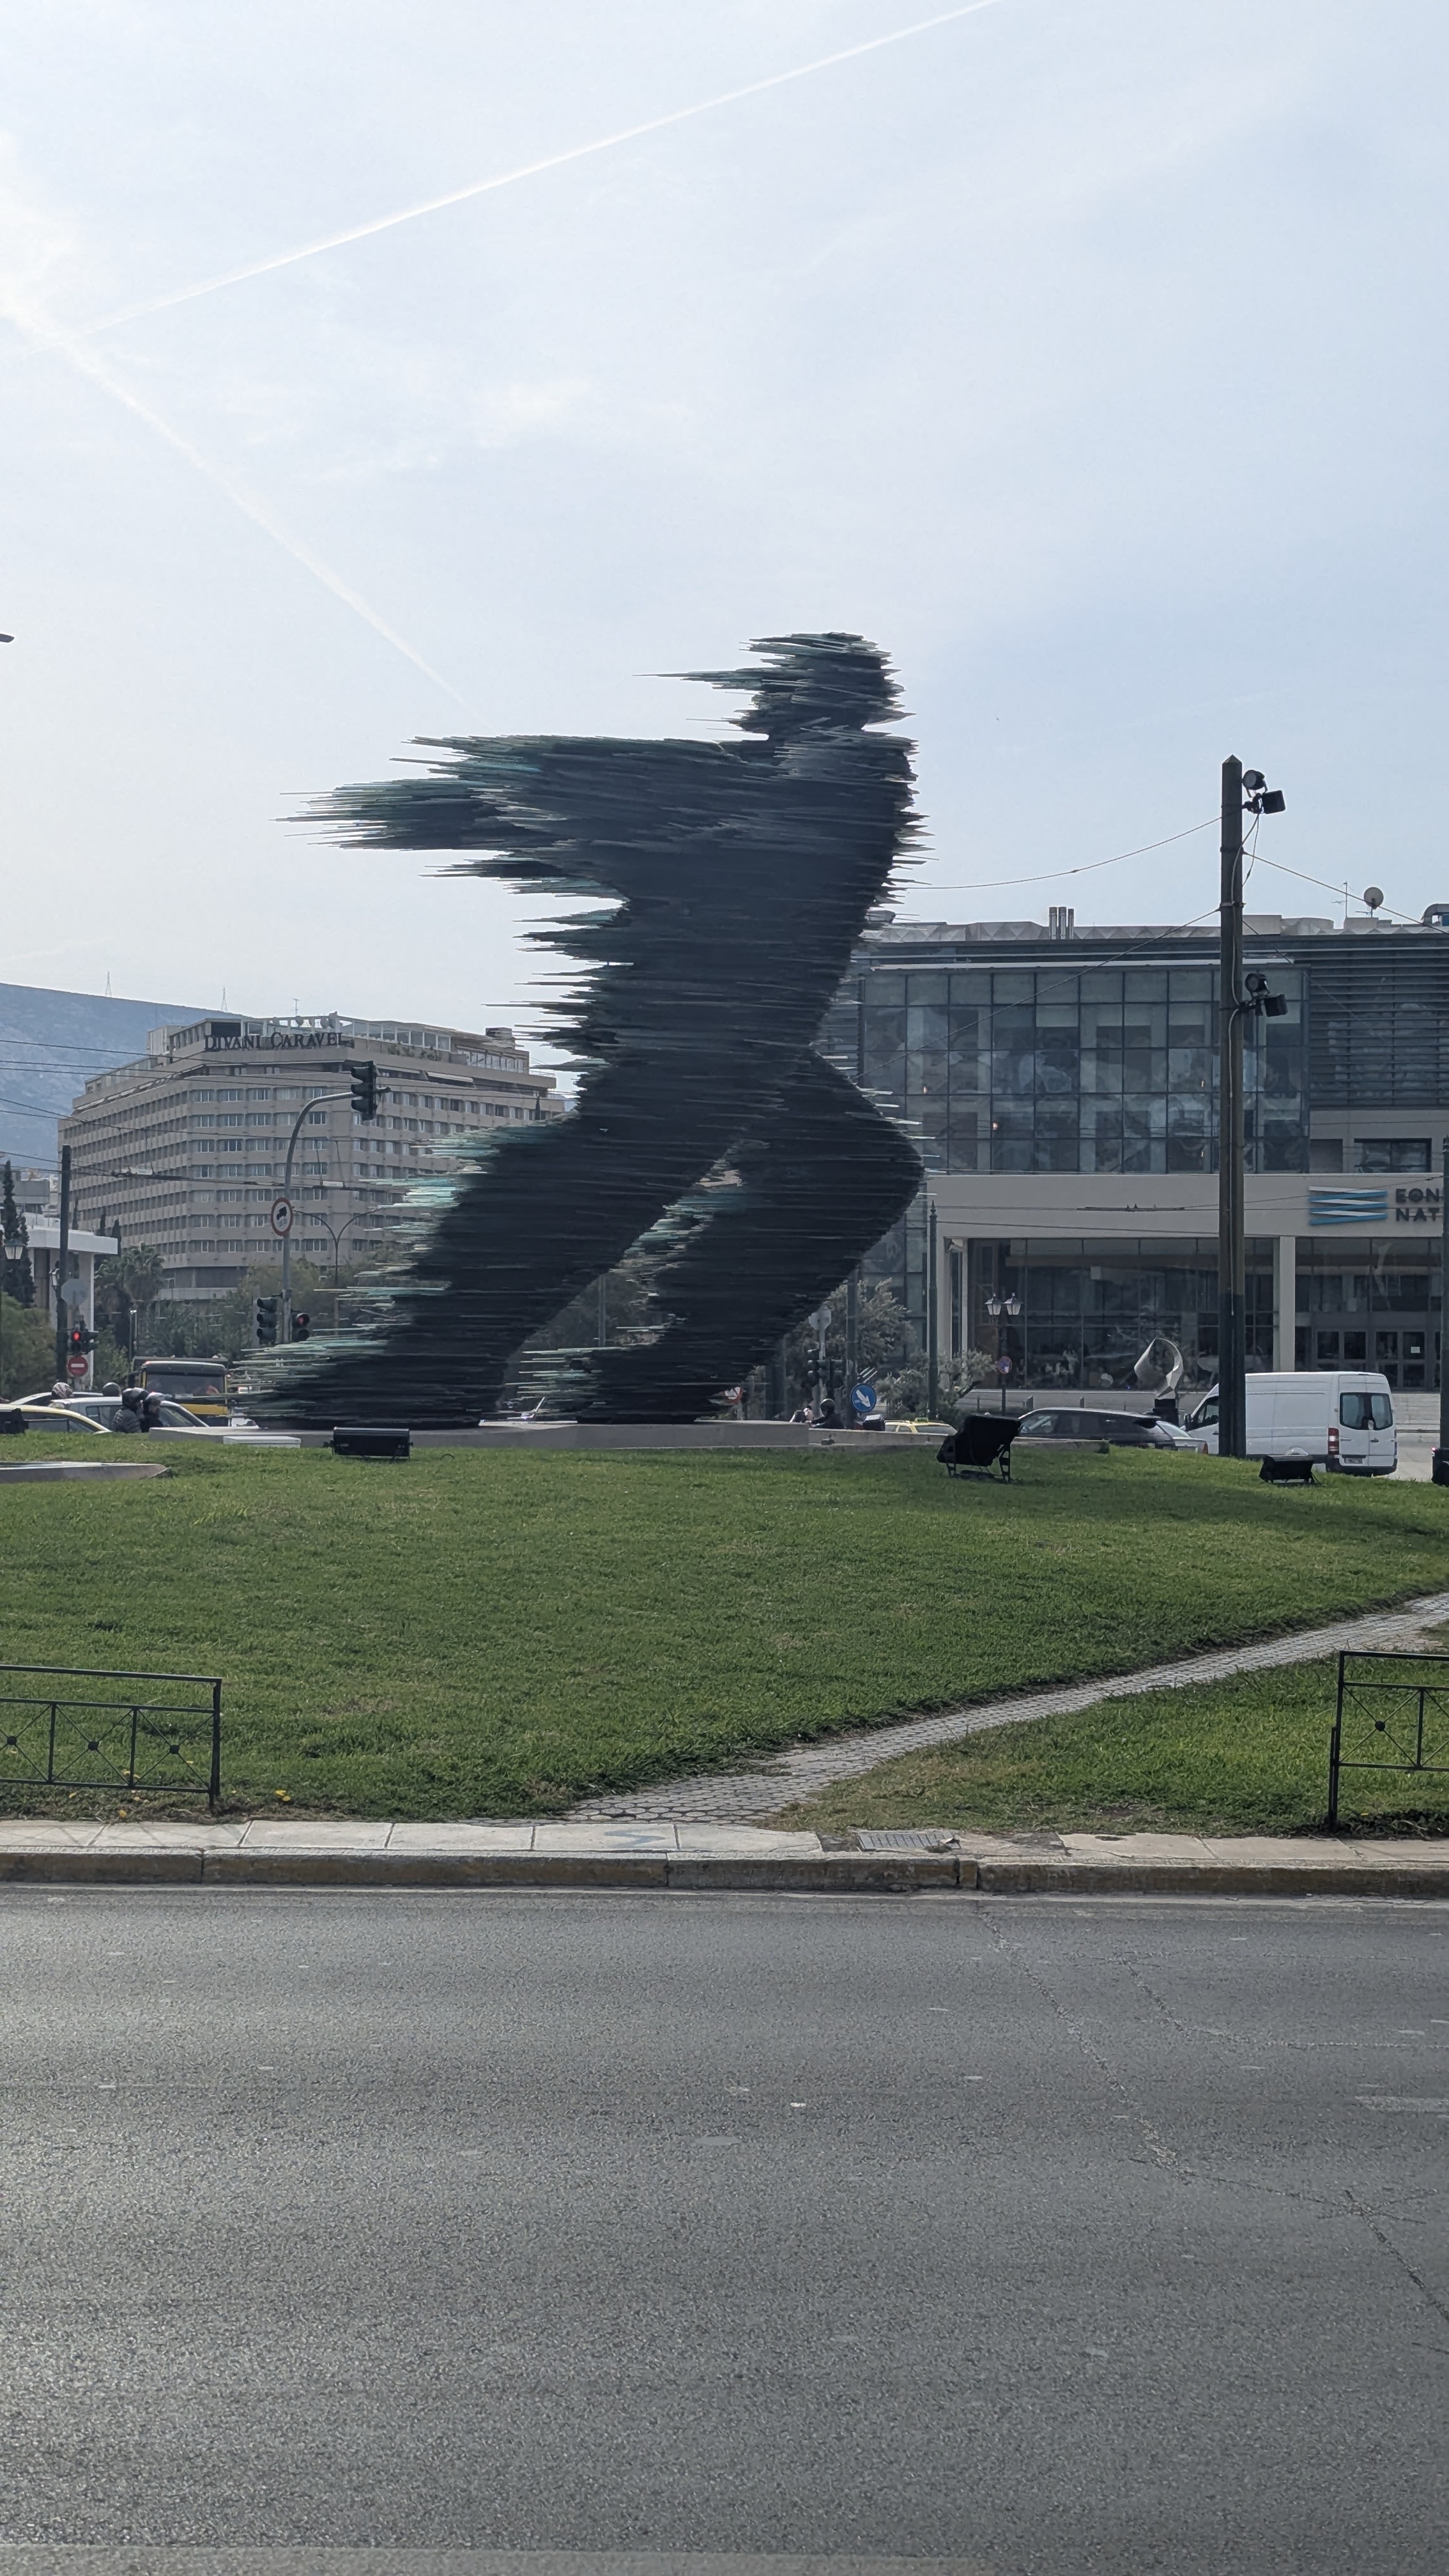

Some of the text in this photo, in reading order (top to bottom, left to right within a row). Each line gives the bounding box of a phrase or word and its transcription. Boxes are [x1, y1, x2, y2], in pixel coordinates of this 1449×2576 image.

[204, 1031, 347, 1050] DIVANI CARAVEL
[1396, 1208, 1441, 1222] NAT
